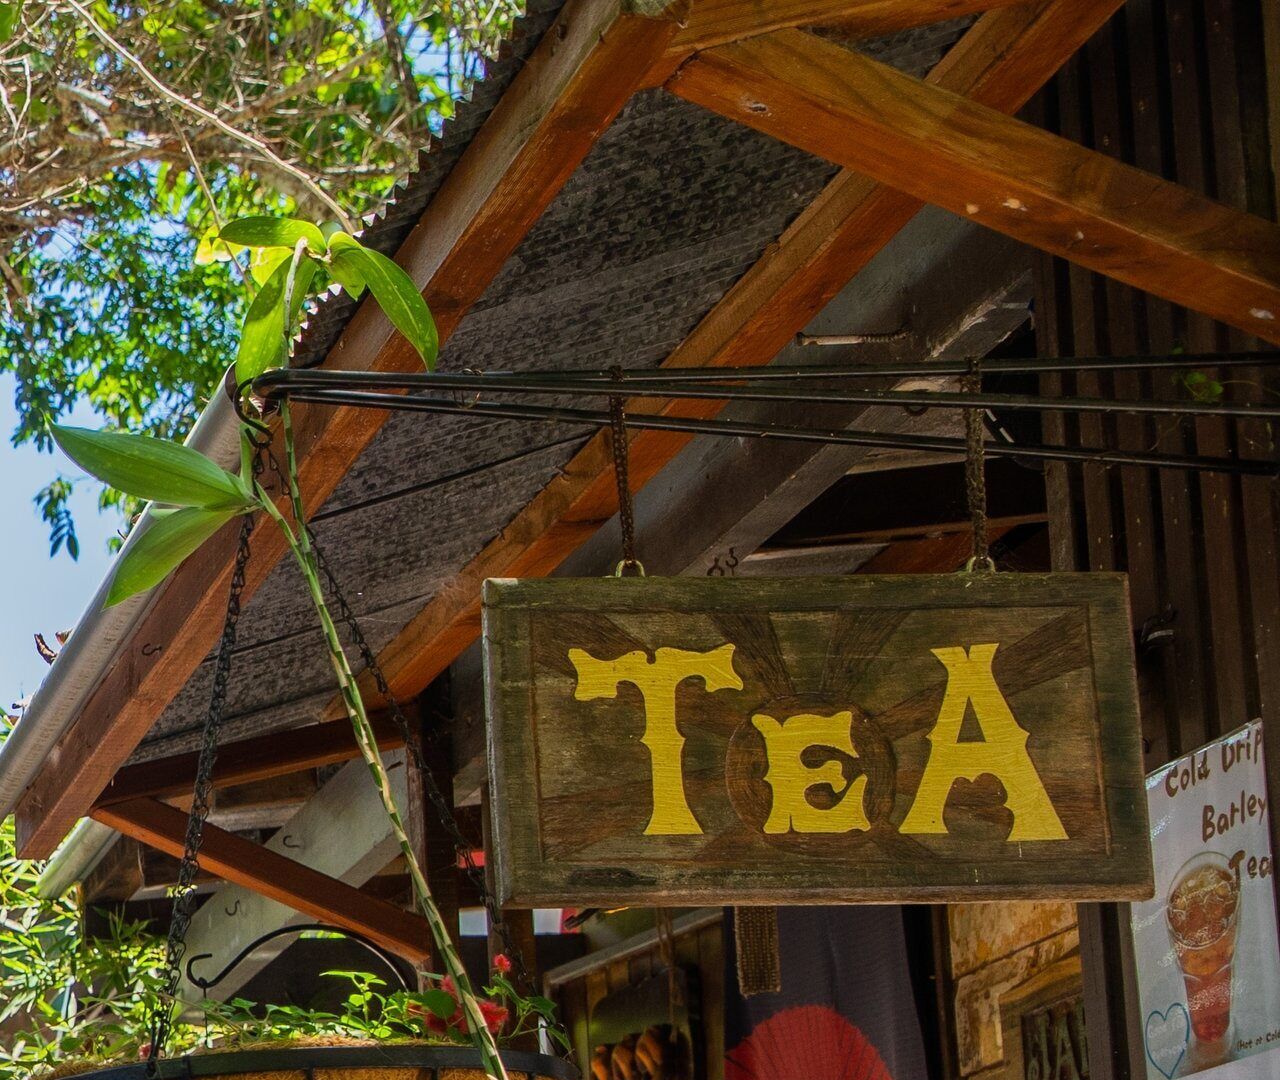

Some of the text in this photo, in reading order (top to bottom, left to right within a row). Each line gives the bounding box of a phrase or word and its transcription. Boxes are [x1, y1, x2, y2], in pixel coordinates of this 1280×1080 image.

[1165, 729, 1263, 798] Cold Drip
[1202, 790, 1266, 844] Barley
[1228, 850, 1273, 888] Tea
